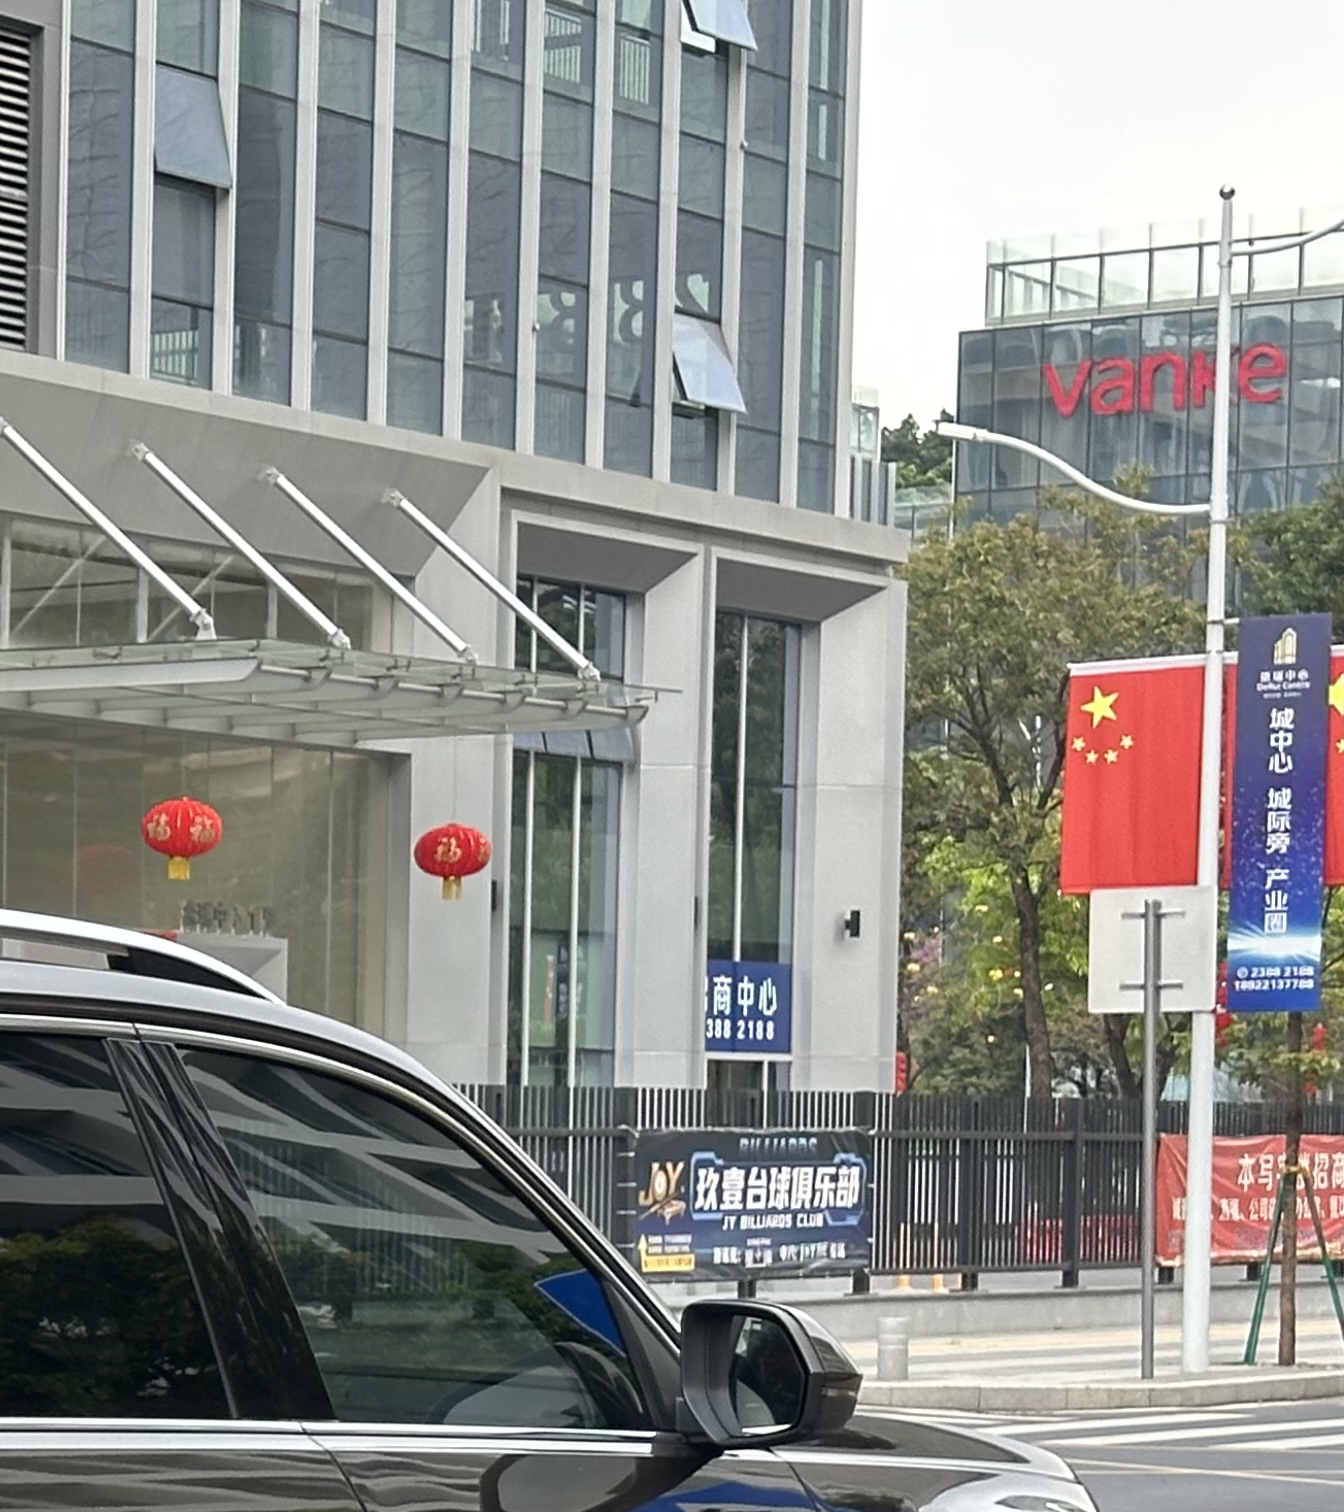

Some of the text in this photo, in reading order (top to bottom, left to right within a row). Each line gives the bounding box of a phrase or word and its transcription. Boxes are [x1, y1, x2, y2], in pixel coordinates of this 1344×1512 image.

[1268, 707, 1295, 774] 城中心
[704, 974, 778, 1017] 商中心
[736, 1019, 775, 1041] 2188
[694, 1166, 862, 1211] 玖壹台球俱乐部
[722, 1215, 737, 1232] JY
[796, 1212, 825, 1229] CLUB
